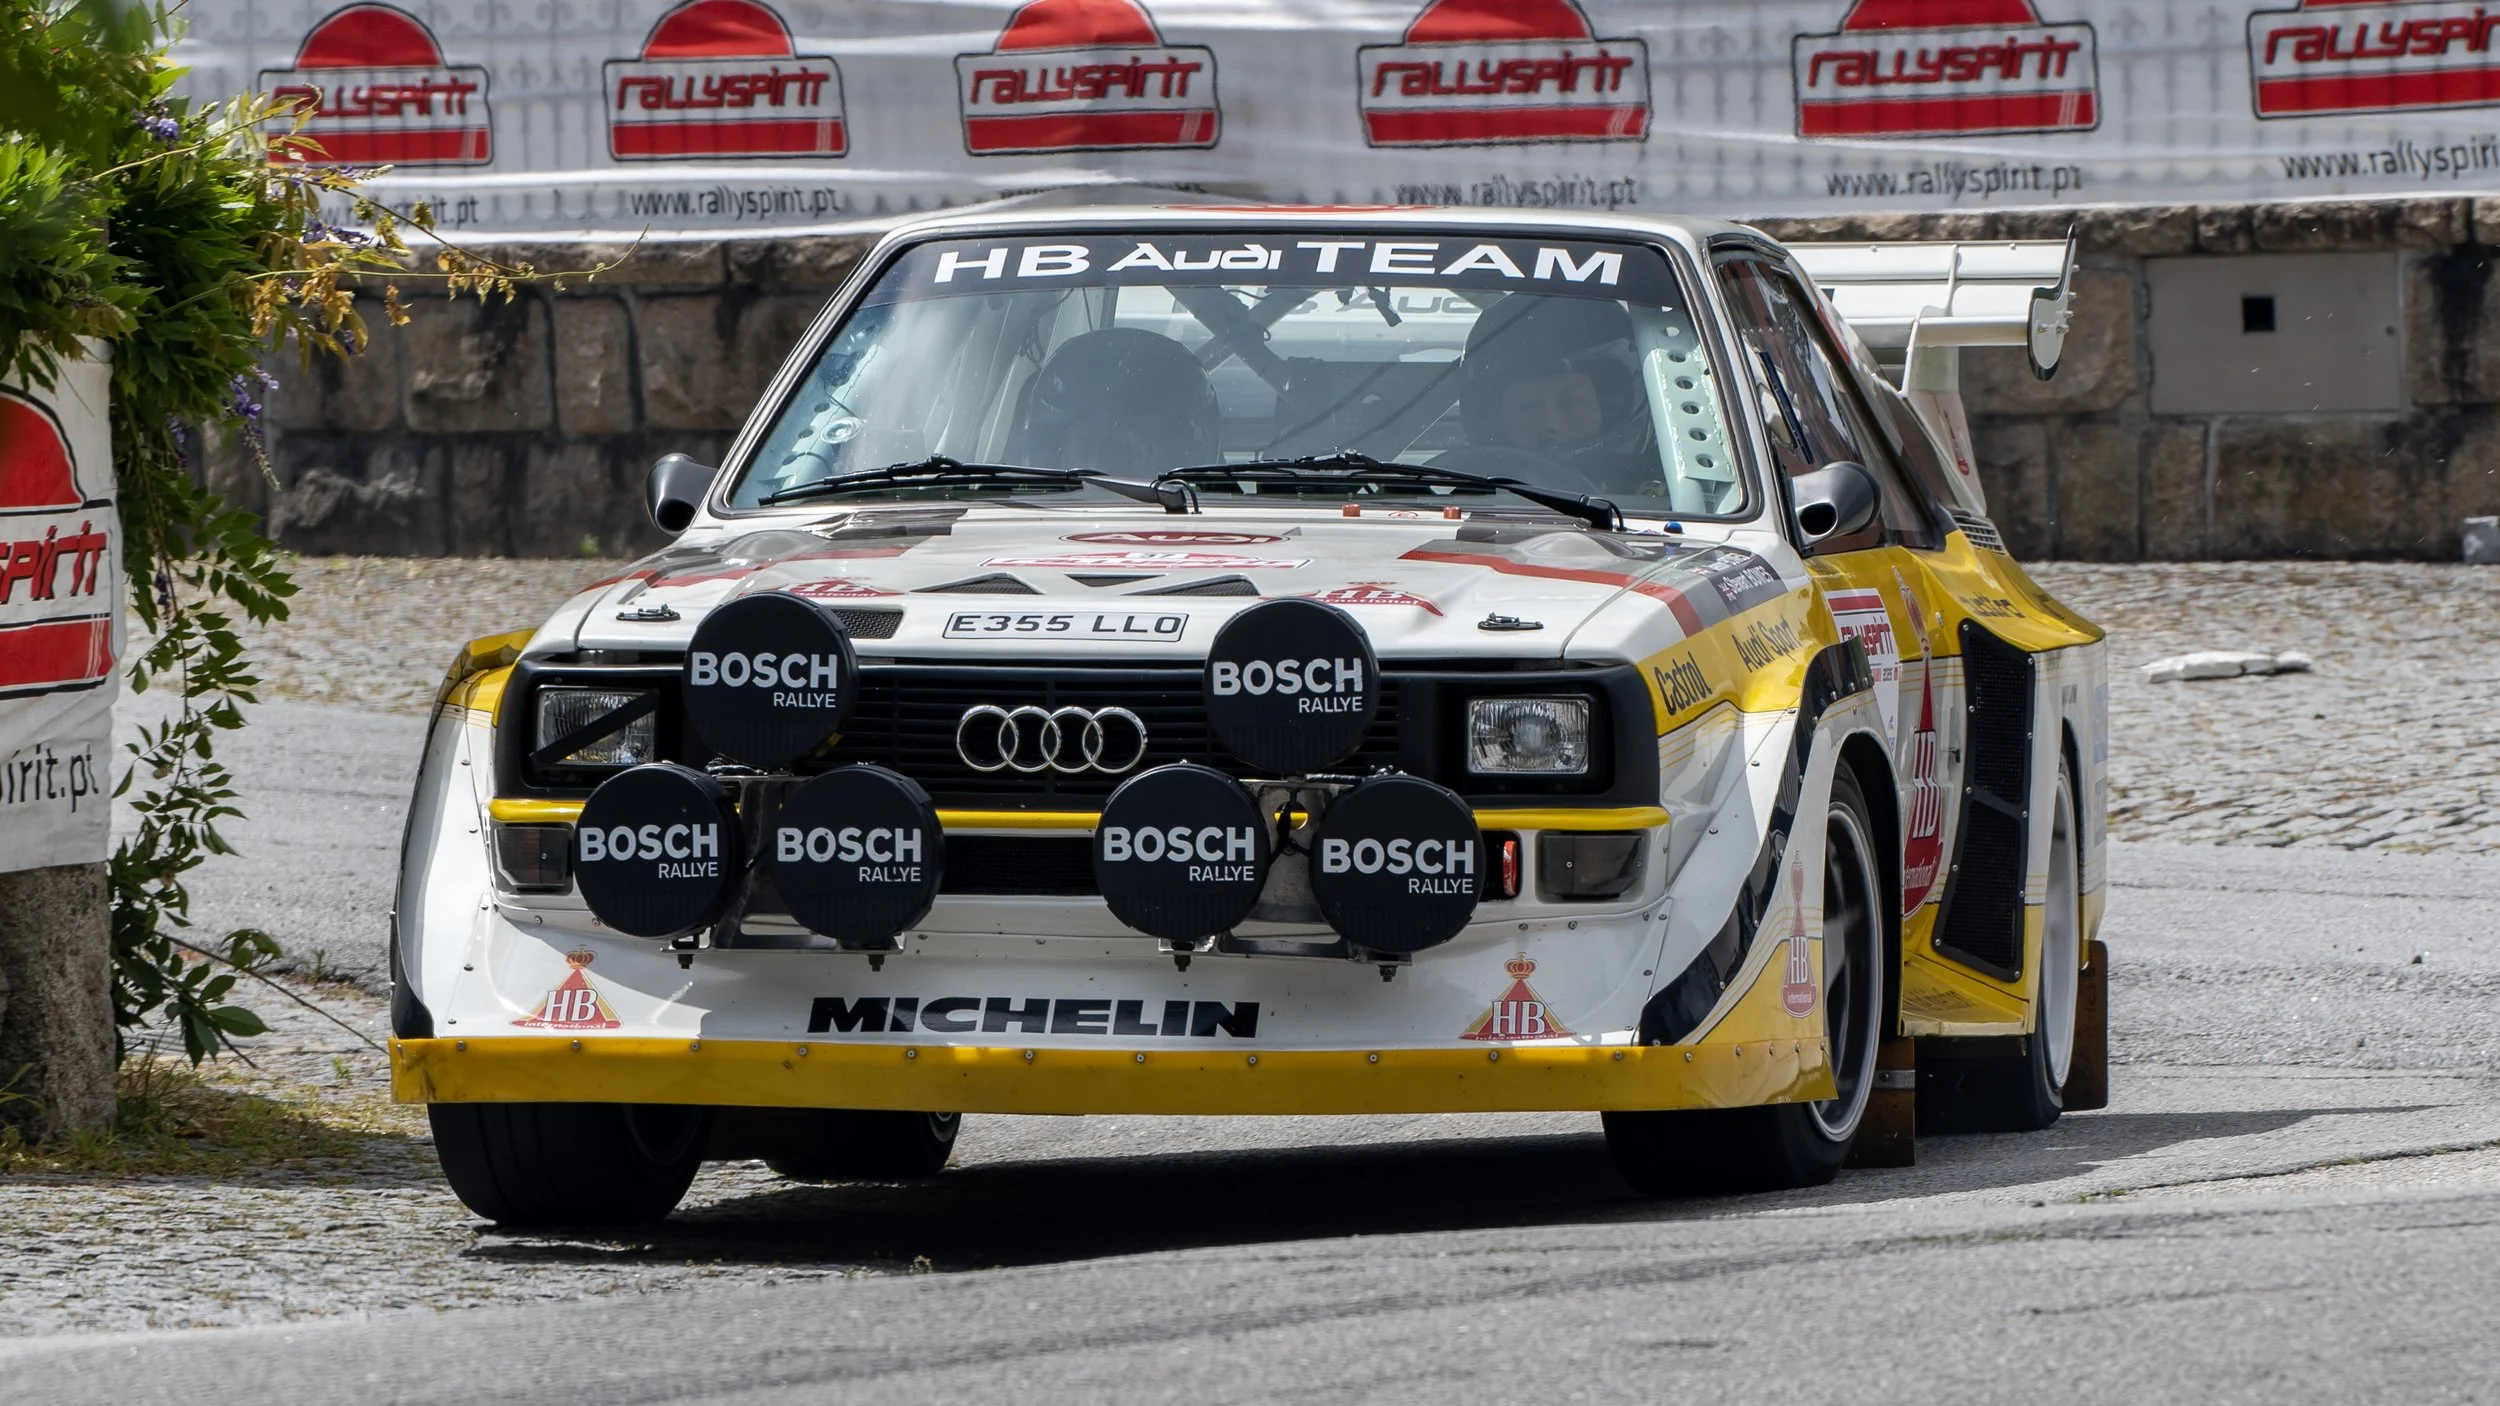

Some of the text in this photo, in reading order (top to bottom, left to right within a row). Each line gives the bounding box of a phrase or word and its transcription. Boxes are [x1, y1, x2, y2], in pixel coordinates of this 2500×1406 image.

[1371, 49, 1633, 97] rallyspirit
[1808, 35, 2080, 87] rallyspirit
[617, 65, 830, 111] rallyspirit
[970, 55, 1202, 105] rallyspirit
[1825, 161, 2083, 201] www.rallyspirit.pt
[631, 184, 841, 221] www.rallyspirit.pt
[934, 244, 1090, 283] HB
[1296, 241, 1624, 285] TEAM
[1313, 589, 1407, 599] HB
[952, 615, 1074, 632] E355
[1731, 613, 1803, 673] Audi Sport
[691, 651, 838, 689] BOSCH
[1212, 657, 1363, 697] BOSCH
[1654, 650, 1713, 716] Castrol
[773, 692, 837, 709] RALLYE
[1299, 696, 1363, 714] RALLYE
[0, 743, 99, 814] irit.pt
[580, 823, 719, 863] BOSCH
[777, 827, 922, 863] BOSCH
[1103, 826, 1255, 863] BOSCH
[1322, 839, 1475, 875] BOSCH
[658, 861, 719, 879] RALLYE
[858, 866, 922, 883] RALLYE
[1189, 865, 1255, 882] RALLYE
[1408, 877, 1474, 895] RALLYE
[1790, 936, 1809, 985] HB
[543, 988, 598, 1022] HB
[807, 996, 1260, 1038] MICHELIN
[1490, 1000, 1546, 1035] HB
